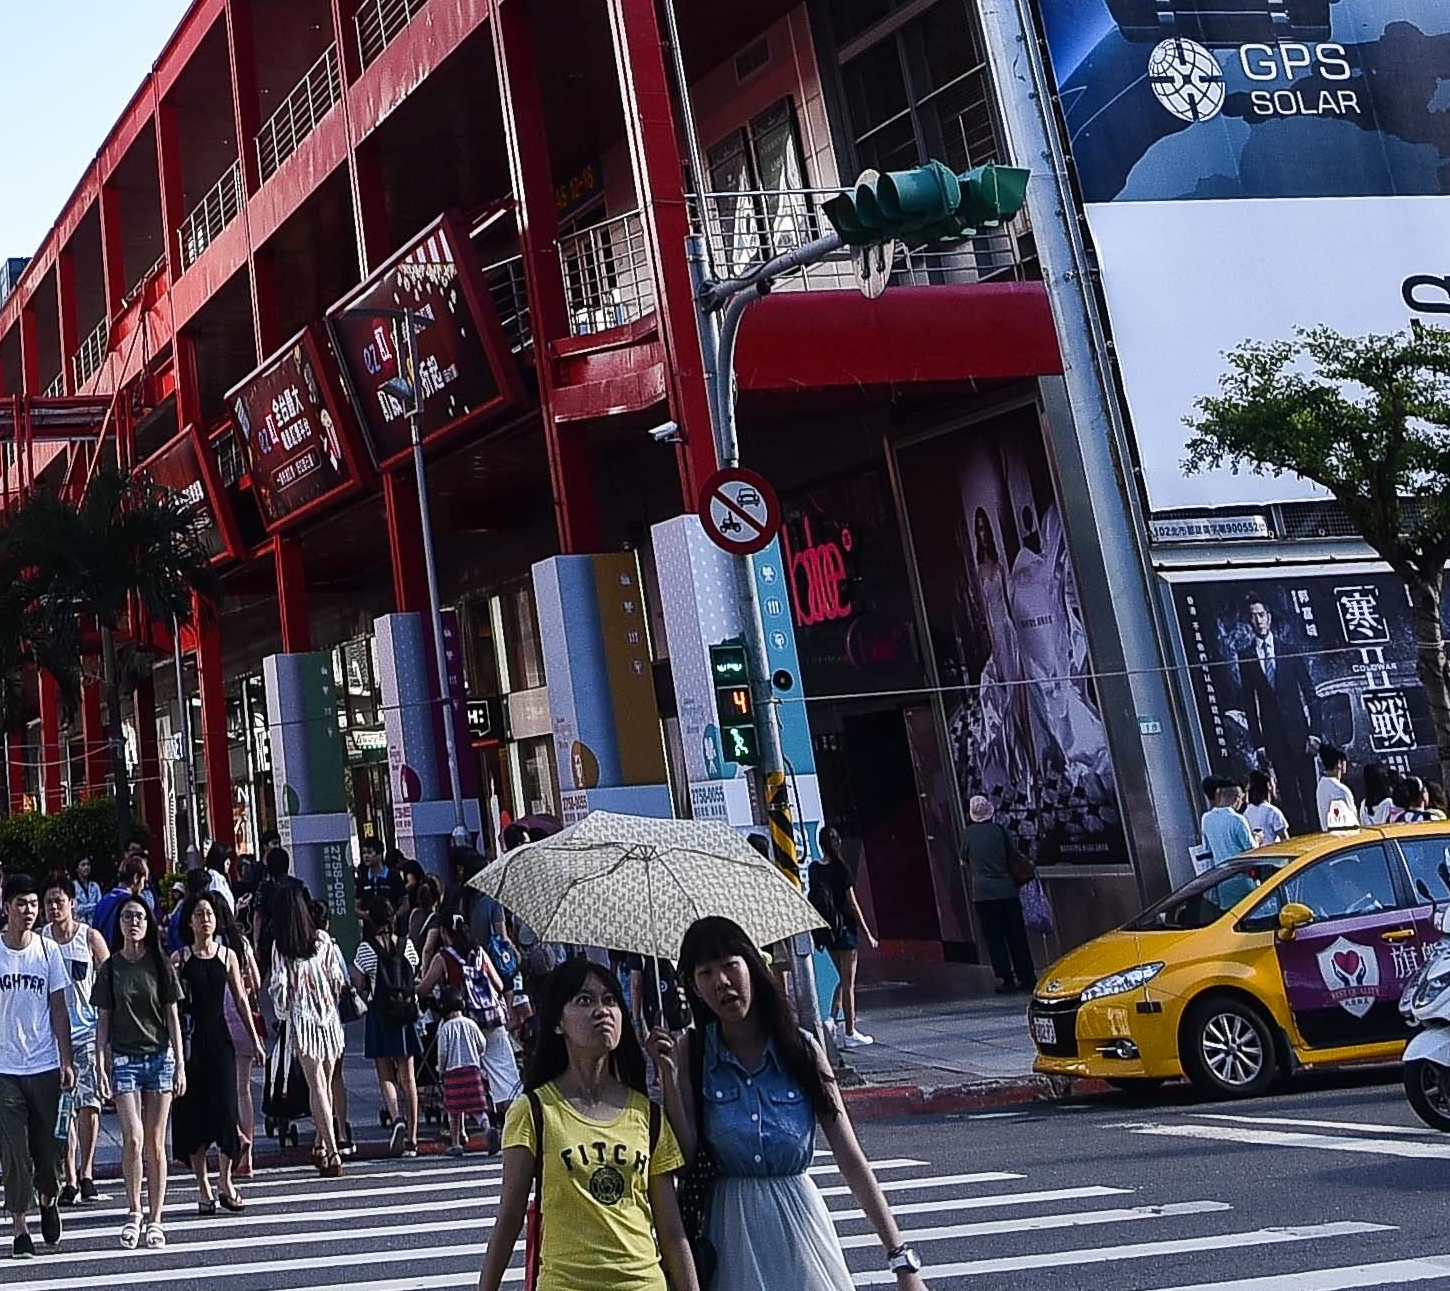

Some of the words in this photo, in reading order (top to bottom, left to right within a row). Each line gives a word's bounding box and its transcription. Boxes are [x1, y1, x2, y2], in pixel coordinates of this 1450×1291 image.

[1242, 44, 1351, 81] GPS
[1251, 91, 1360, 116] SOLAR
[1341, 592, 1383, 638] 寒
[733, 691, 747, 714] 4
[561, 1142, 647, 1174] FITCH
